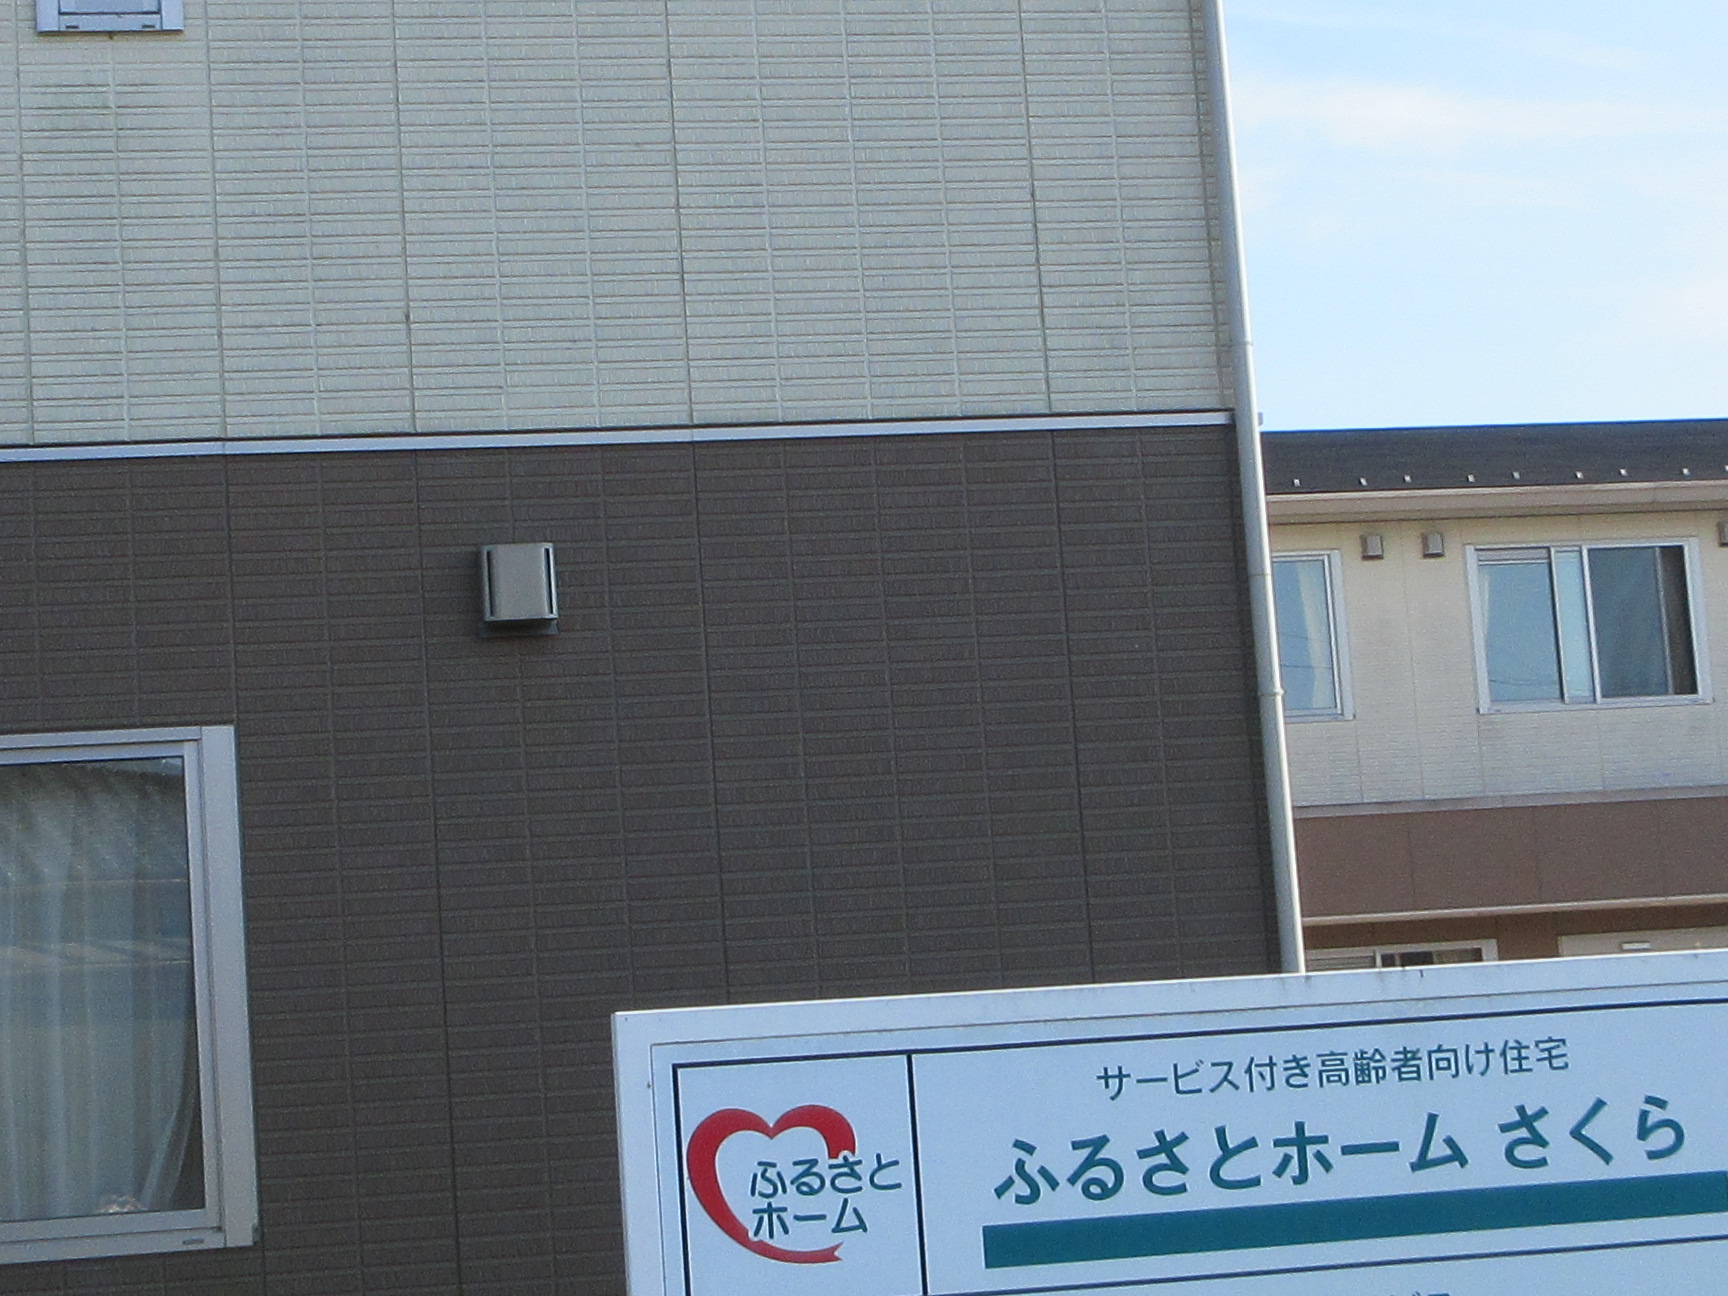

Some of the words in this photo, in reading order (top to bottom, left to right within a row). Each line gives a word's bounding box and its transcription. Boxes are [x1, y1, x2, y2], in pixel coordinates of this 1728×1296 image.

[1095, 1035, 1569, 1102] サービス付き高齢者向け住宅
[749, 1152, 904, 1199] ふるさと
[992, 1111, 1470, 1206] ふるさとホーム
[1496, 1094, 1686, 1171] さくら
[751, 1197, 869, 1240] ホーム
